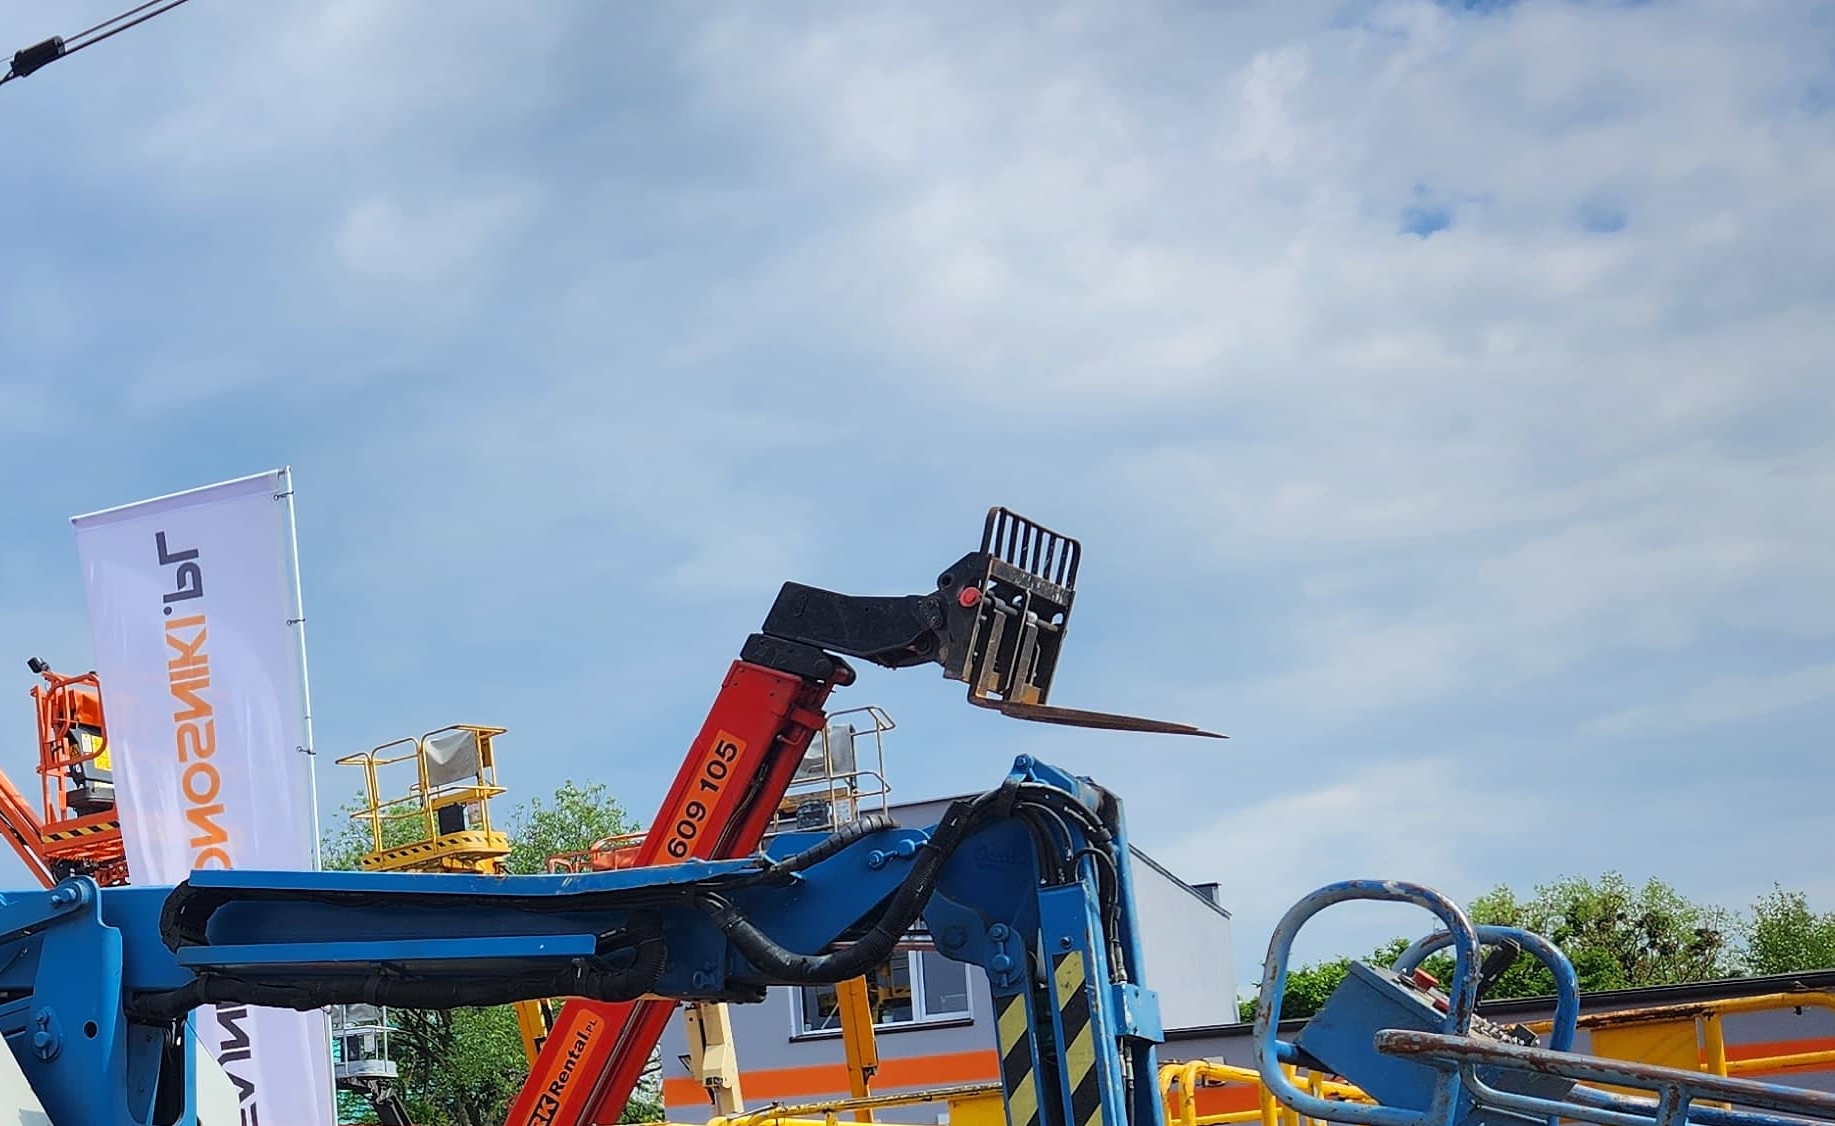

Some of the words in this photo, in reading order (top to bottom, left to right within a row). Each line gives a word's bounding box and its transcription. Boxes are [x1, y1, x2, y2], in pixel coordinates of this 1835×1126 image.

[667, 801, 707, 858] 609
[700, 739, 738, 793] 105
[548, 1019, 597, 1098] Rental.PL
